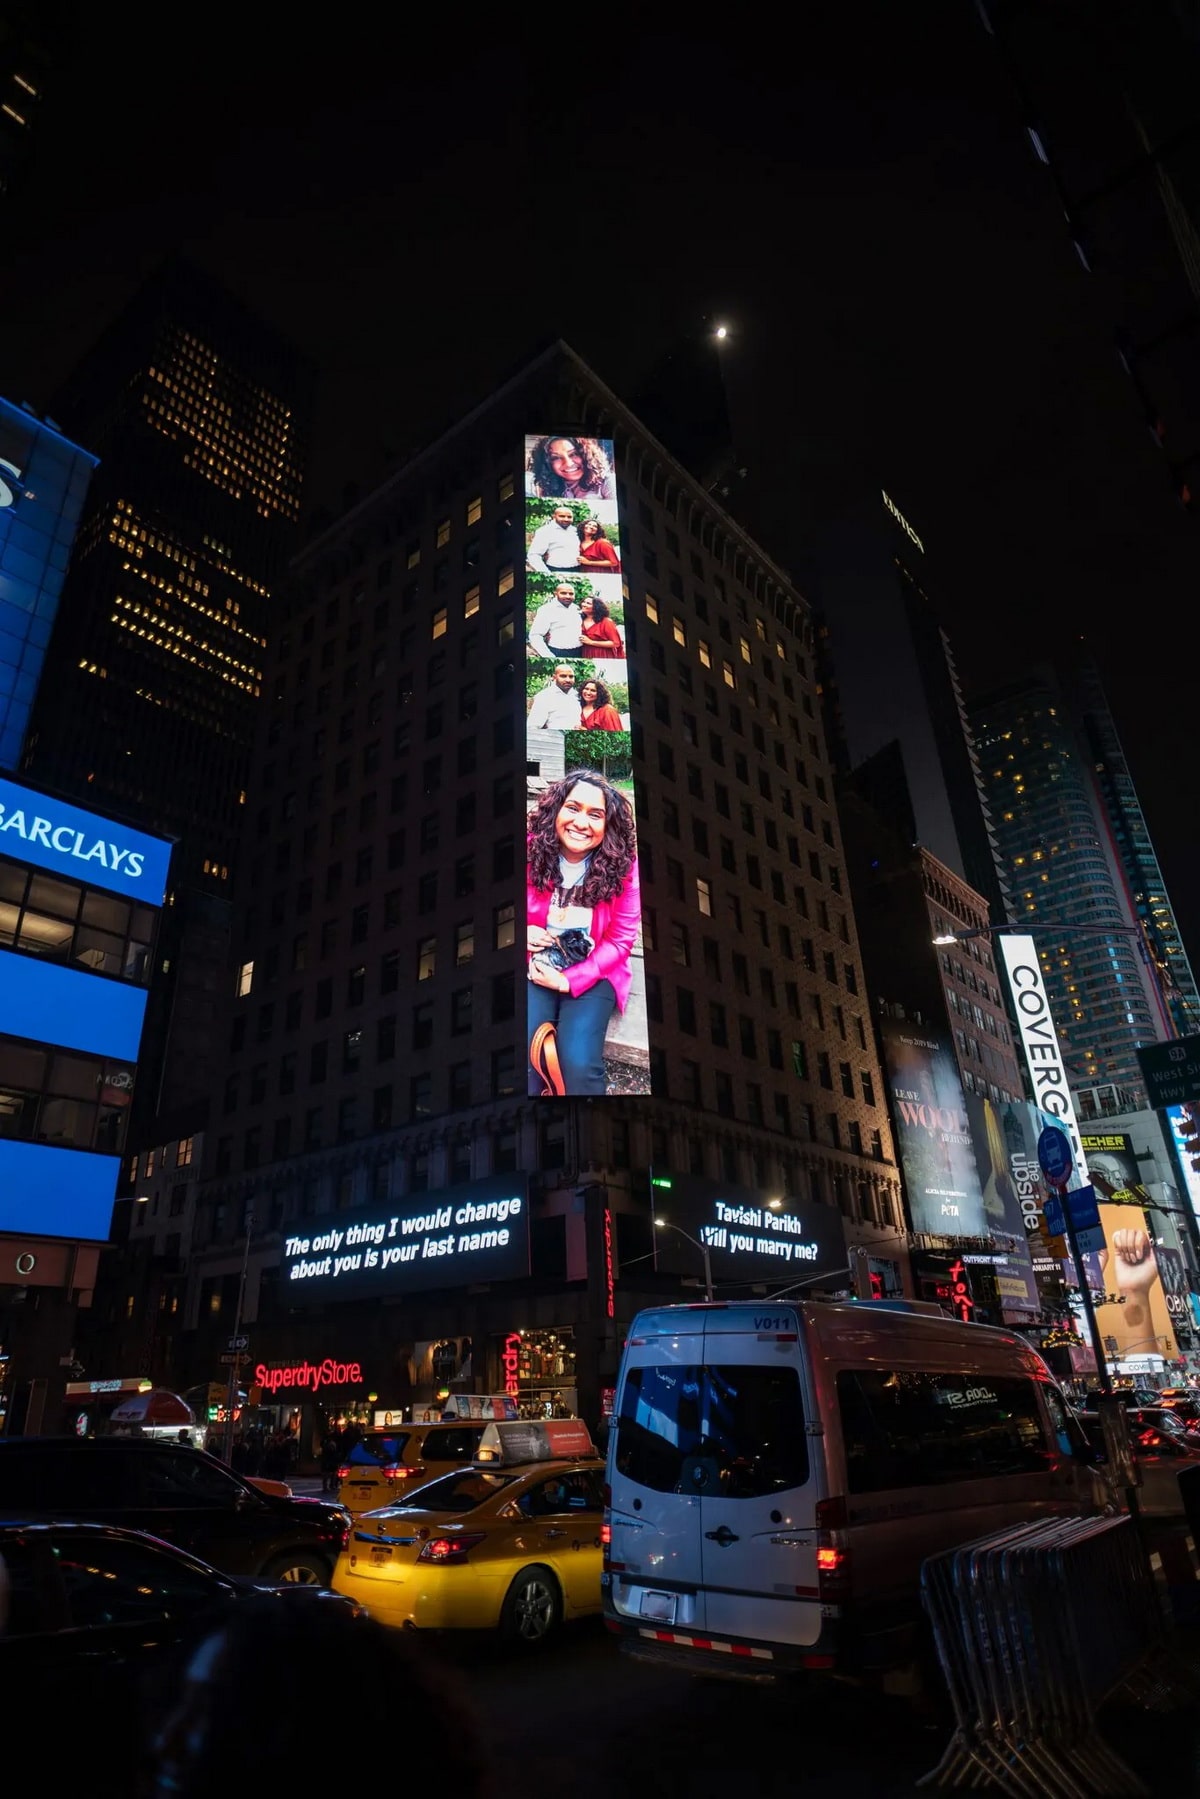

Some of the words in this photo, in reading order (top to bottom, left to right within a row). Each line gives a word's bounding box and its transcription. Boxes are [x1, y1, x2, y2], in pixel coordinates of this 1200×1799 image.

[1152, 1066, 1184, 1083] West
[895, 1088, 920, 1101] LEAVE
[1160, 1084, 1185, 1100] Hwy
[896, 1100, 968, 1135] WOOL
[1081, 1135, 1124, 1147] SCHER
[1027, 1160, 1040, 1182] the
[1011, 1152, 1042, 1230] upside
[286, 1237, 310, 1257] The
[312, 1229, 344, 1252] only
[345, 1222, 386, 1245] thing
[387, 1217, 399, 1238] I
[402, 1206, 453, 1235] would
[455, 1197, 522, 1223] change
[715, 1201, 762, 1228] Tavishi
[764, 1211, 802, 1235] Parikh
[290, 1256, 332, 1280] about
[333, 1254, 361, 1277] you
[364, 1248, 379, 1268] is
[381, 1244, 420, 1269] your
[422, 1234, 455, 1258] last
[458, 1228, 510, 1253] name
[729, 1233, 754, 1254] you
[756, 1237, 793, 1261] marry
[795, 1243, 819, 1261] me?
[603, 1207, 615, 1319] Superdry
[1032, 1263, 1055, 1272] ANUARY
[753, 1317, 791, 1331] V011
[501, 1331, 522, 1405] erdry
